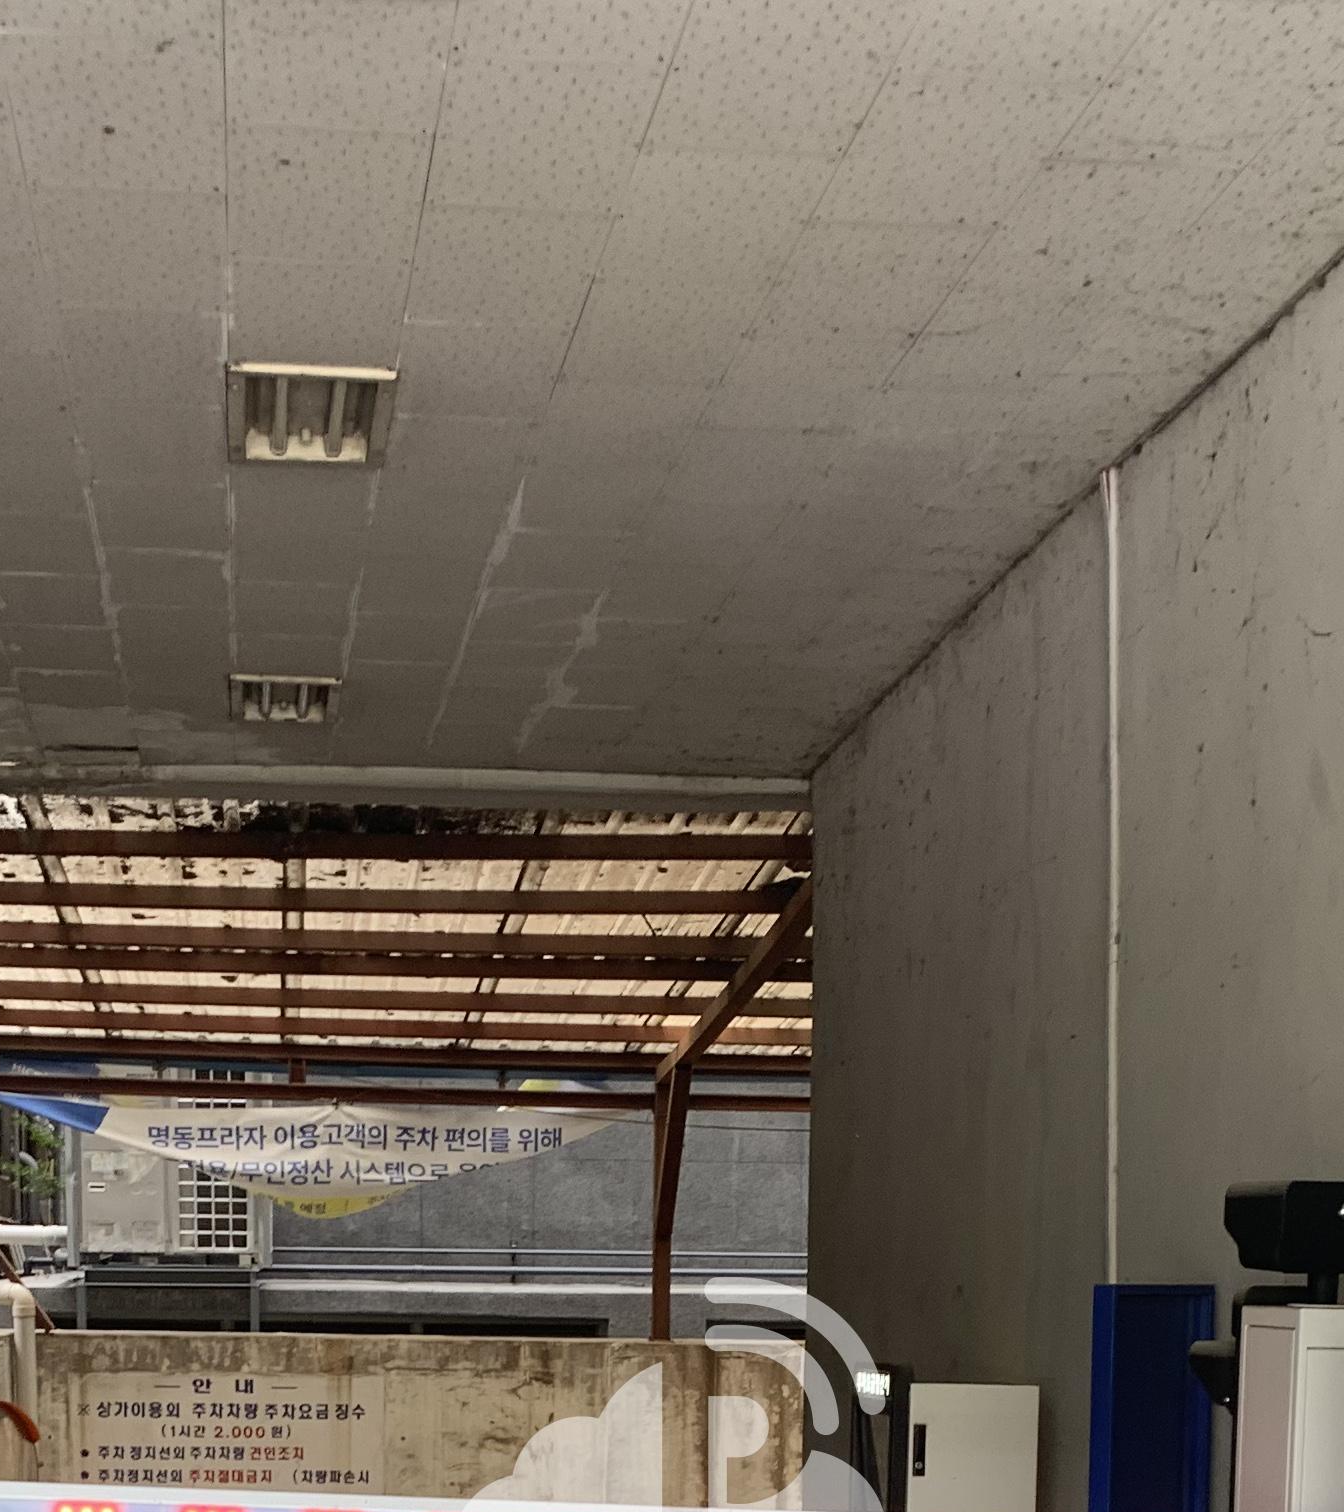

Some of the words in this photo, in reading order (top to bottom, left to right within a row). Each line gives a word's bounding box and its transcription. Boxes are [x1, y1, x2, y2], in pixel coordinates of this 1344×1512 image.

[148, 1125, 267, 1150] 명동프라자
[274, 1123, 388, 1150] 이용고객의
[394, 1126, 439, 1151] 주차
[444, 1127, 511, 1153] 편의를
[517, 1127, 563, 1152] 위해
[340, 1160, 449, 1186] 시스템으로
[96, 1401, 180, 1419] 상가이용외
[192, 1402, 258, 1420] 주차차량
[161, 1423, 206, 1439] (1시간
[190, 1446, 245, 1460] 주차차량
